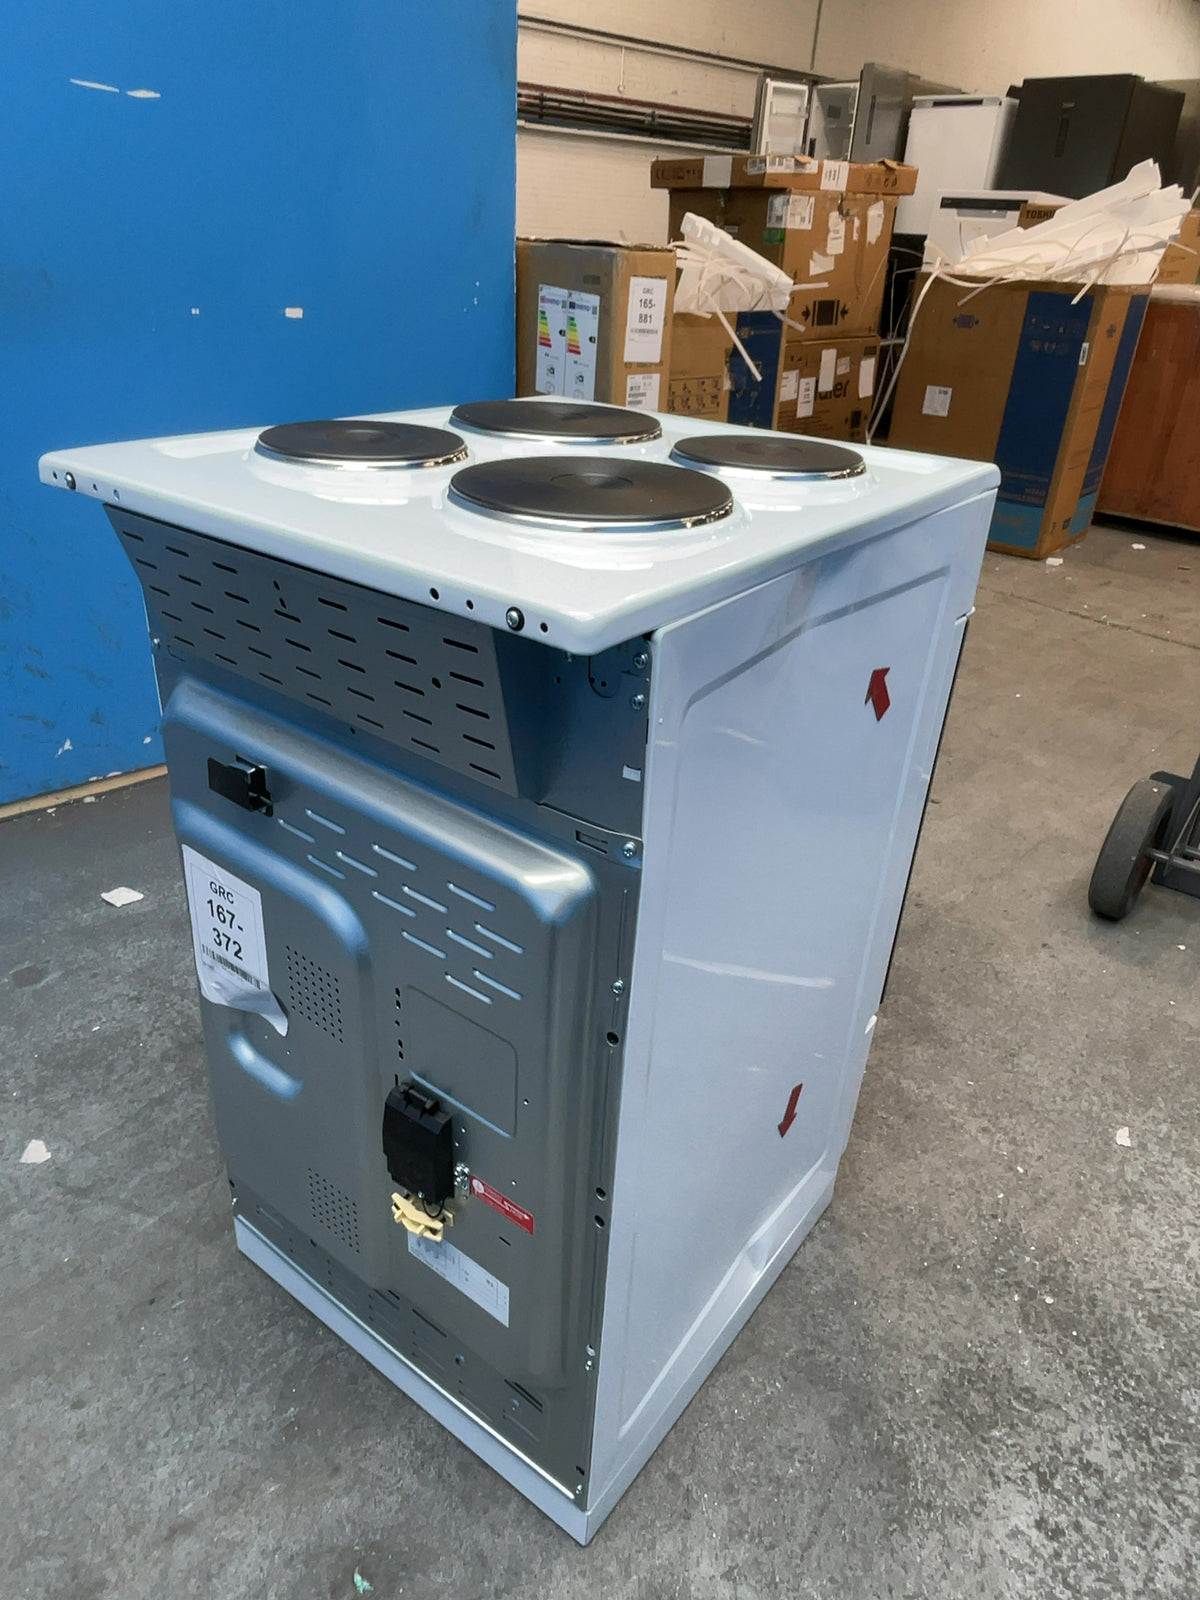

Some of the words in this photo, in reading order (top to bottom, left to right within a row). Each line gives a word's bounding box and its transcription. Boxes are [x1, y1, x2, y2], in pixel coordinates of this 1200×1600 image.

[642, 287, 654, 295] GRC
[639, 298, 656, 309] 165-
[638, 313, 652, 324] 881
[209, 881, 235, 904] GRC
[206, 898, 244, 932] 167-
[212, 927, 244, 962] 372
